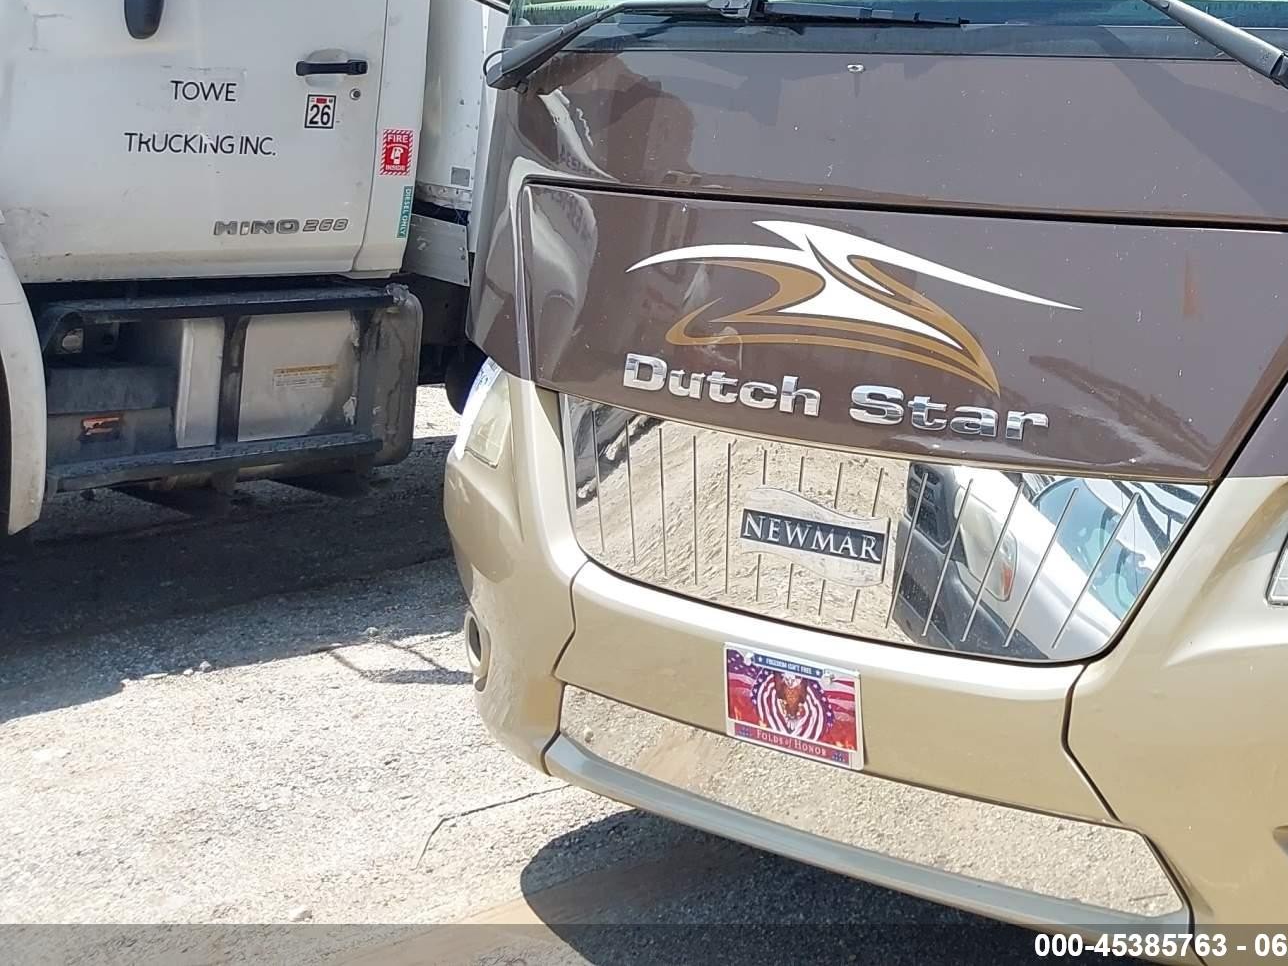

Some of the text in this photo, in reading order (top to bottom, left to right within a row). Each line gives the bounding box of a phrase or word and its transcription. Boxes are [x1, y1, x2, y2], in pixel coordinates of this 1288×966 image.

[170, 80, 237, 102] TOWE
[309, 104, 331, 126] 26
[124, 132, 276, 156] TRUCKING INC.
[387, 134, 409, 143] FIRE
[385, 164, 406, 172] INSIDE
[399, 188, 412, 235] DIESEL ONLY
[213, 218, 349, 236] HINO 268
[623, 353, 1049, 441] Dutch Star
[742, 511, 881, 563] NEWMAR
